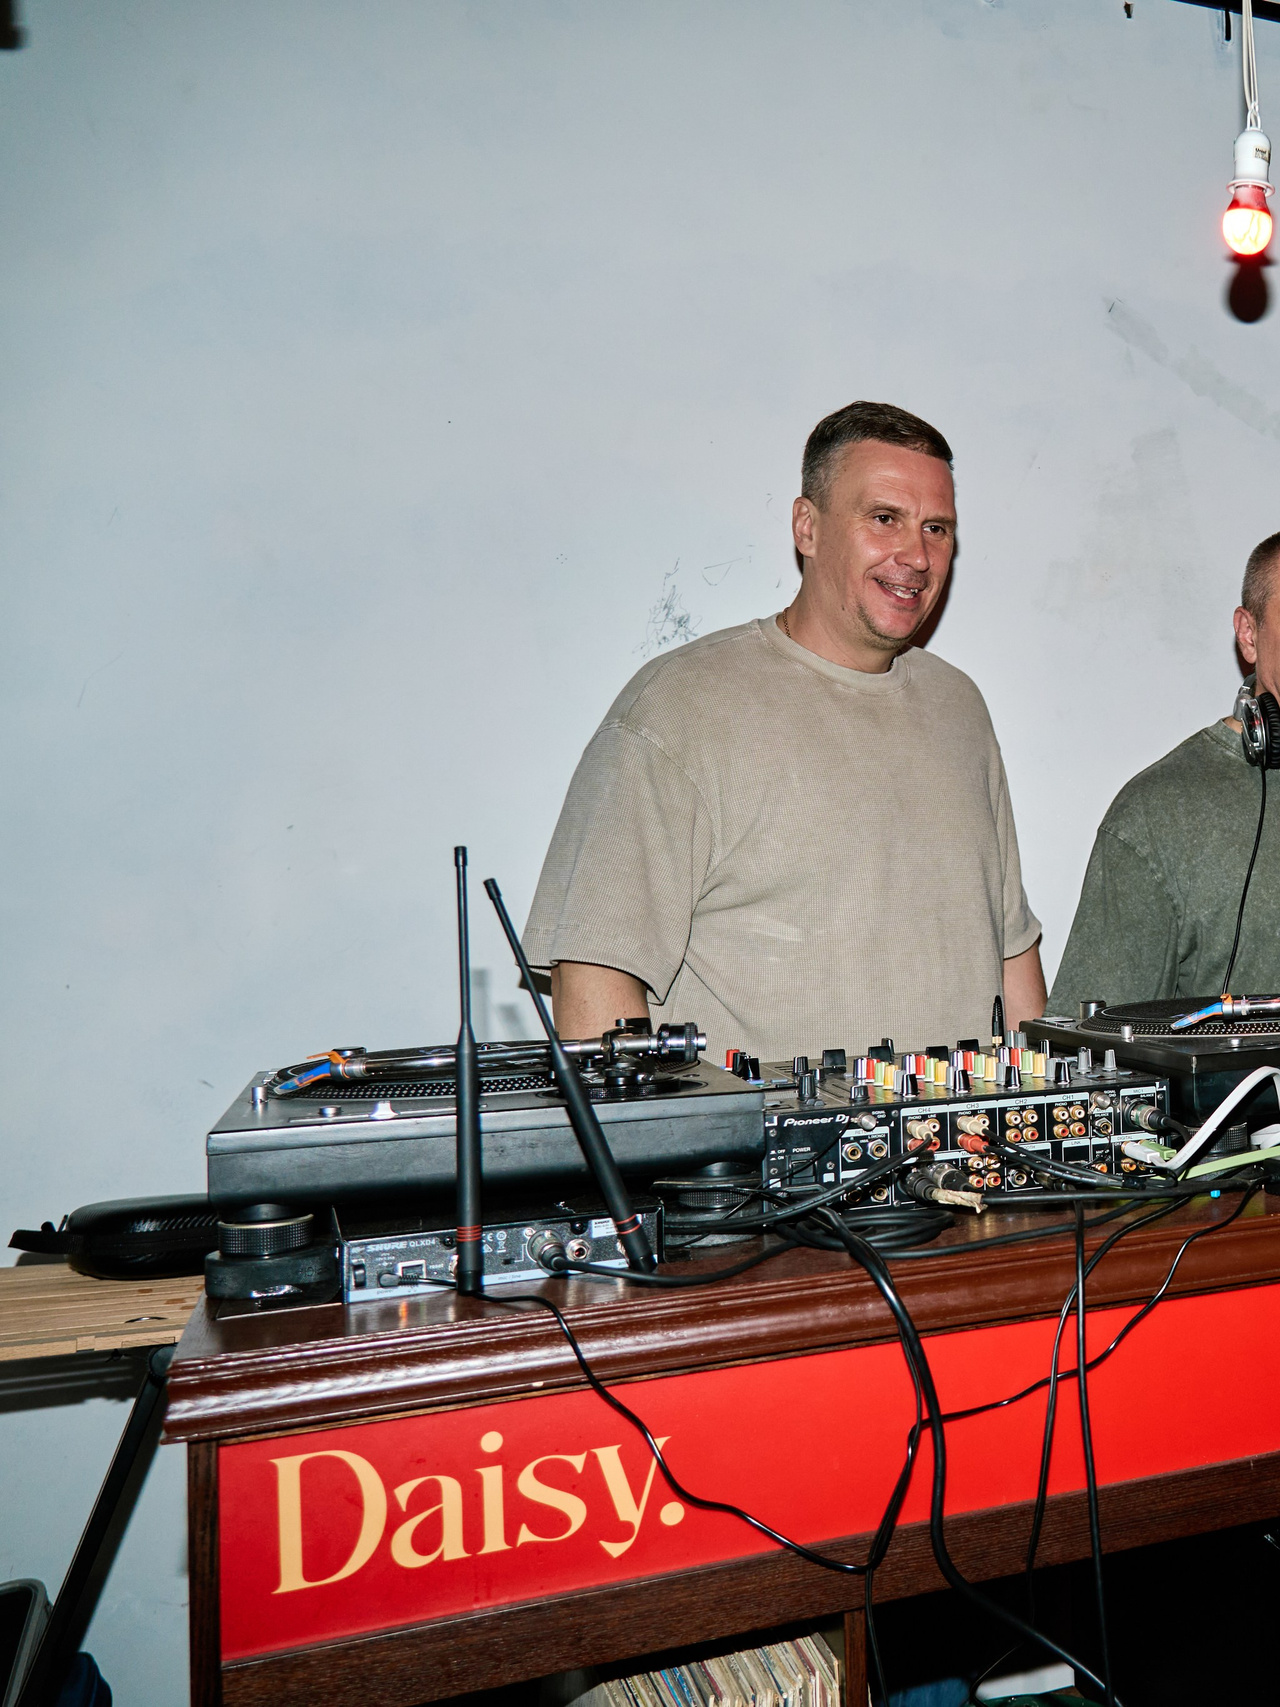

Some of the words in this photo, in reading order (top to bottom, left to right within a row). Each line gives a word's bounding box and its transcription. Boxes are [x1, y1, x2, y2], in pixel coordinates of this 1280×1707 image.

[783, 1117, 833, 1127] Pioneer
[366, 1241, 407, 1252] SHURE
[409, 1239, 436, 1248] QLXD4
[270, 1430, 685, 1594] Daisy.
